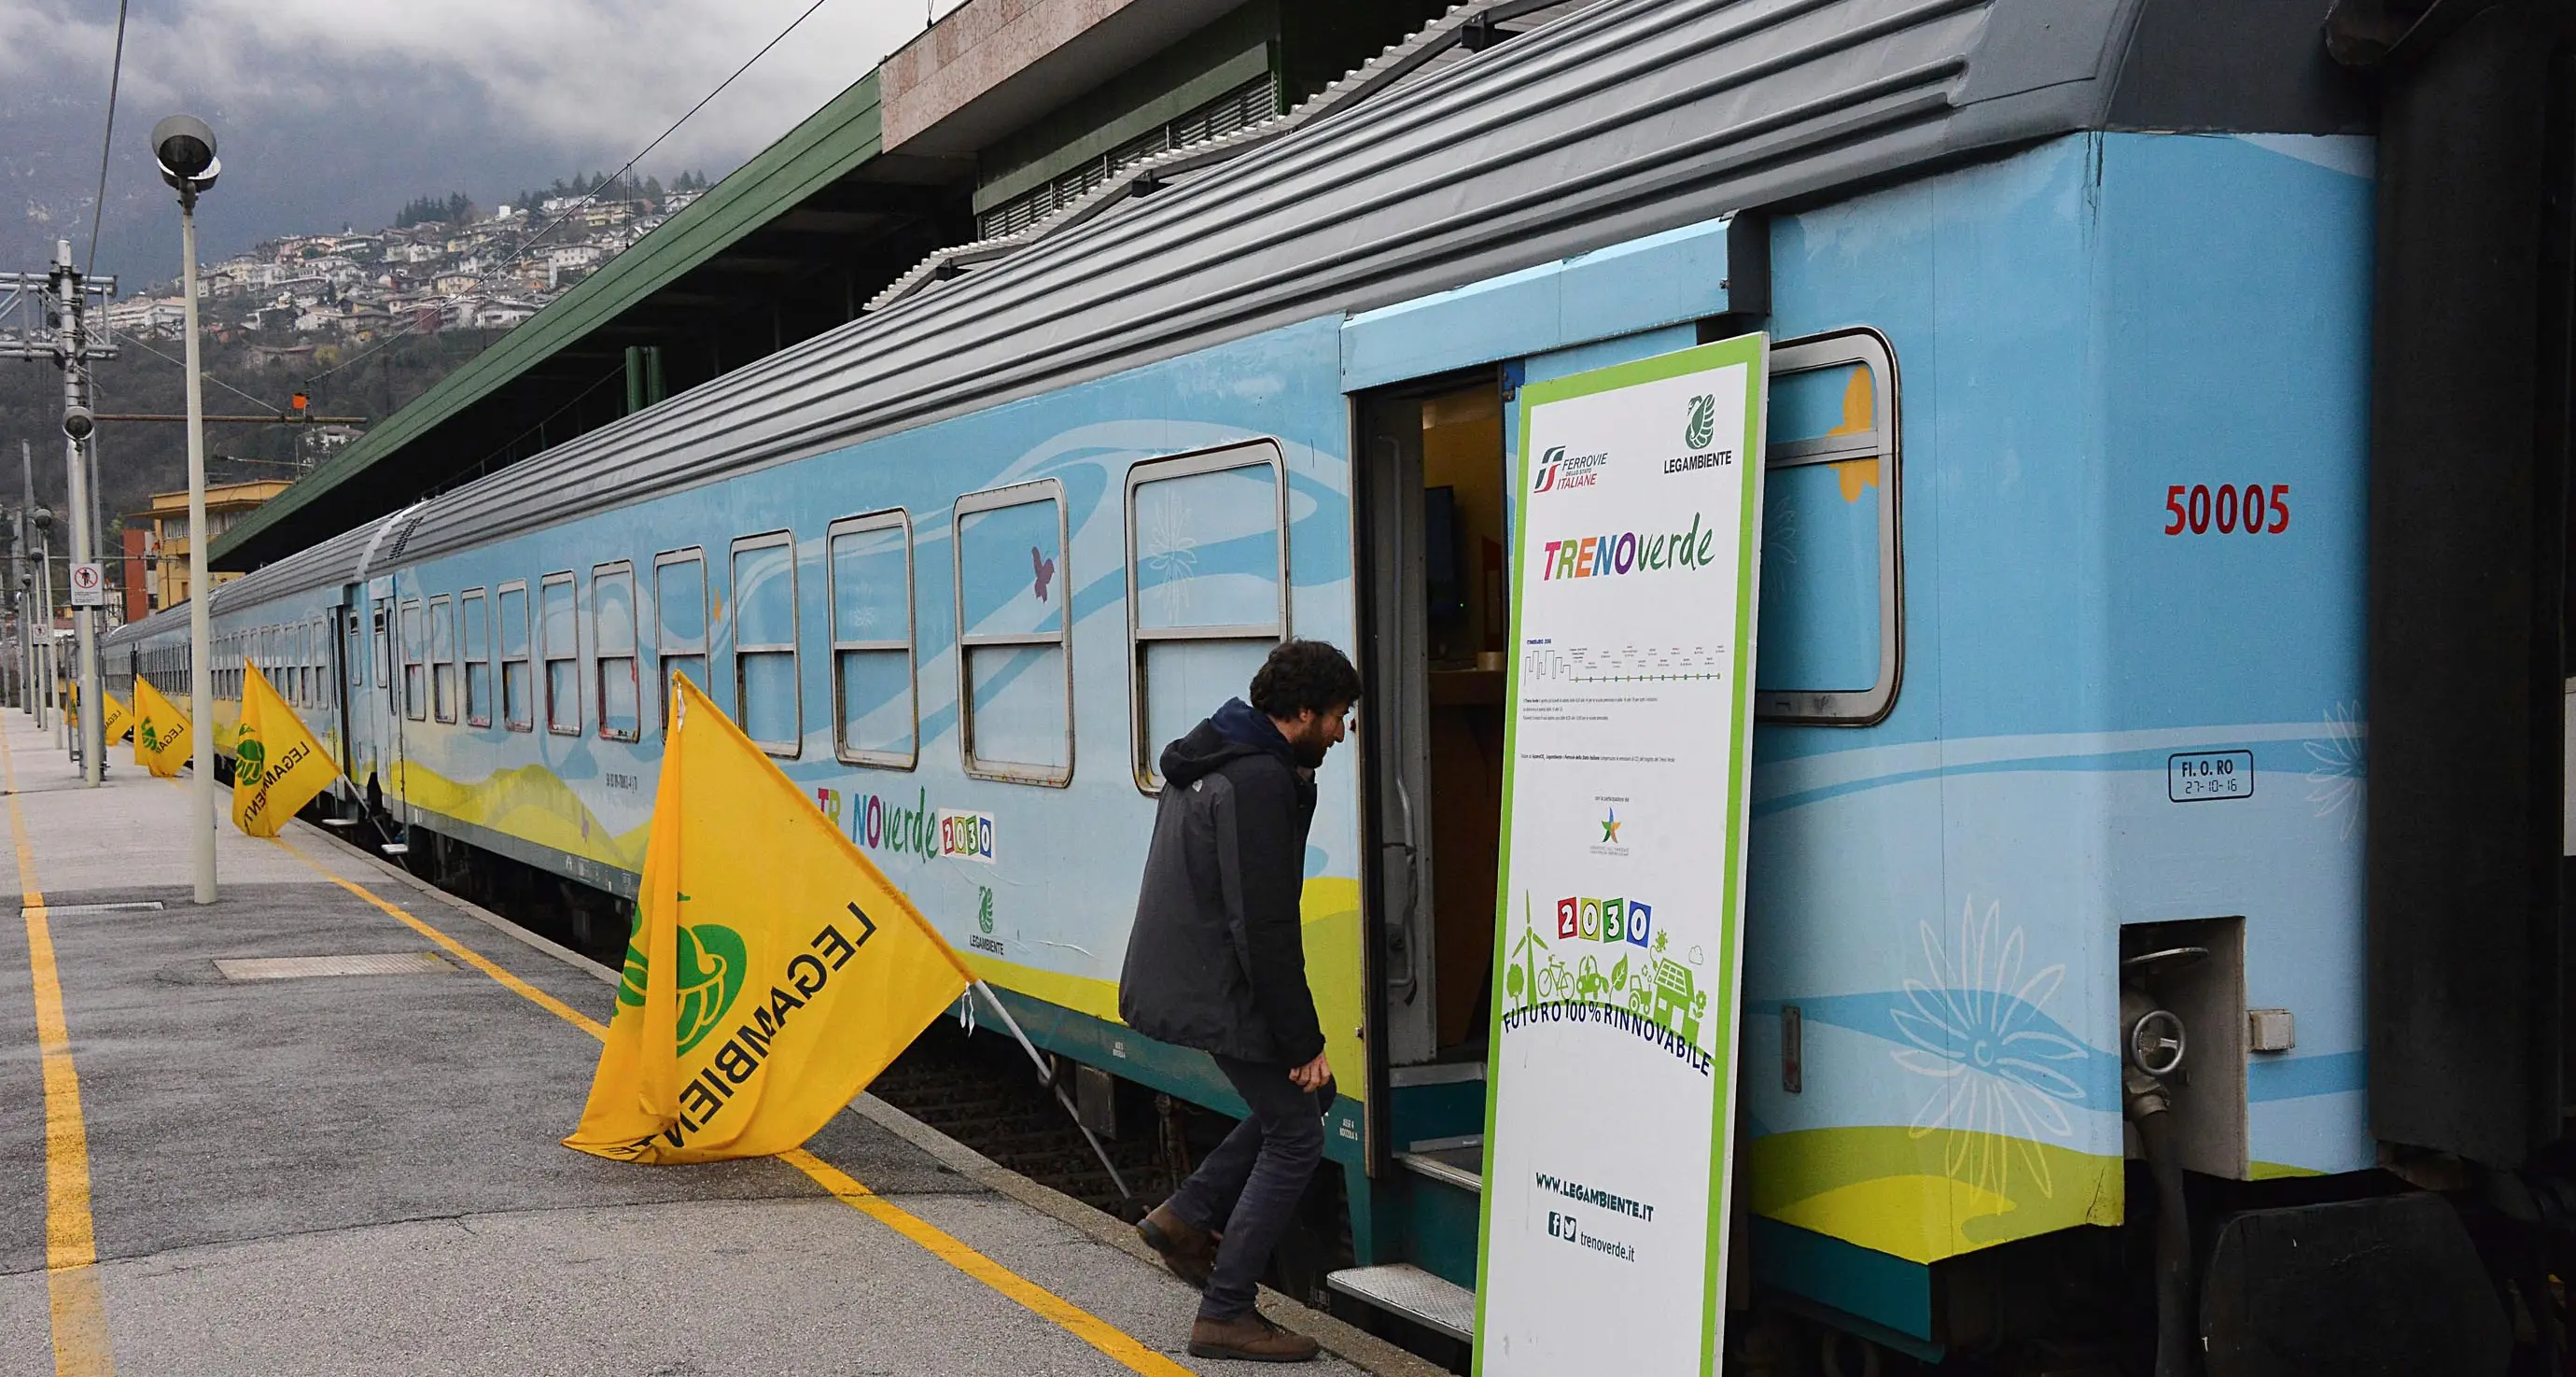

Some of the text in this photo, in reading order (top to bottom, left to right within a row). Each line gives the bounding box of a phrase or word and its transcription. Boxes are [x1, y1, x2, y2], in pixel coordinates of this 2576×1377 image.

[1561, 453, 1608, 471] FERROVIE
[1663, 450, 1732, 474] LEGAMBIENTE
[1557, 473, 1597, 490] ITALIANE
[2164, 484, 2289, 536] 50005
[2217, 759, 2233, 775] RO
[943, 817, 991, 856] 2030
[1560, 900, 1649, 943] 2030
[970, 934, 1004, 955] LEGAMBIENTE
[1503, 1001, 1561, 1033] FUTURO
[1604, 1003, 1712, 1076] RINNOVABILE
[1535, 1172, 1654, 1222] WWW.LEGAMBIENTE.IT
[1580, 1231, 1635, 1262] trenoverde.it
